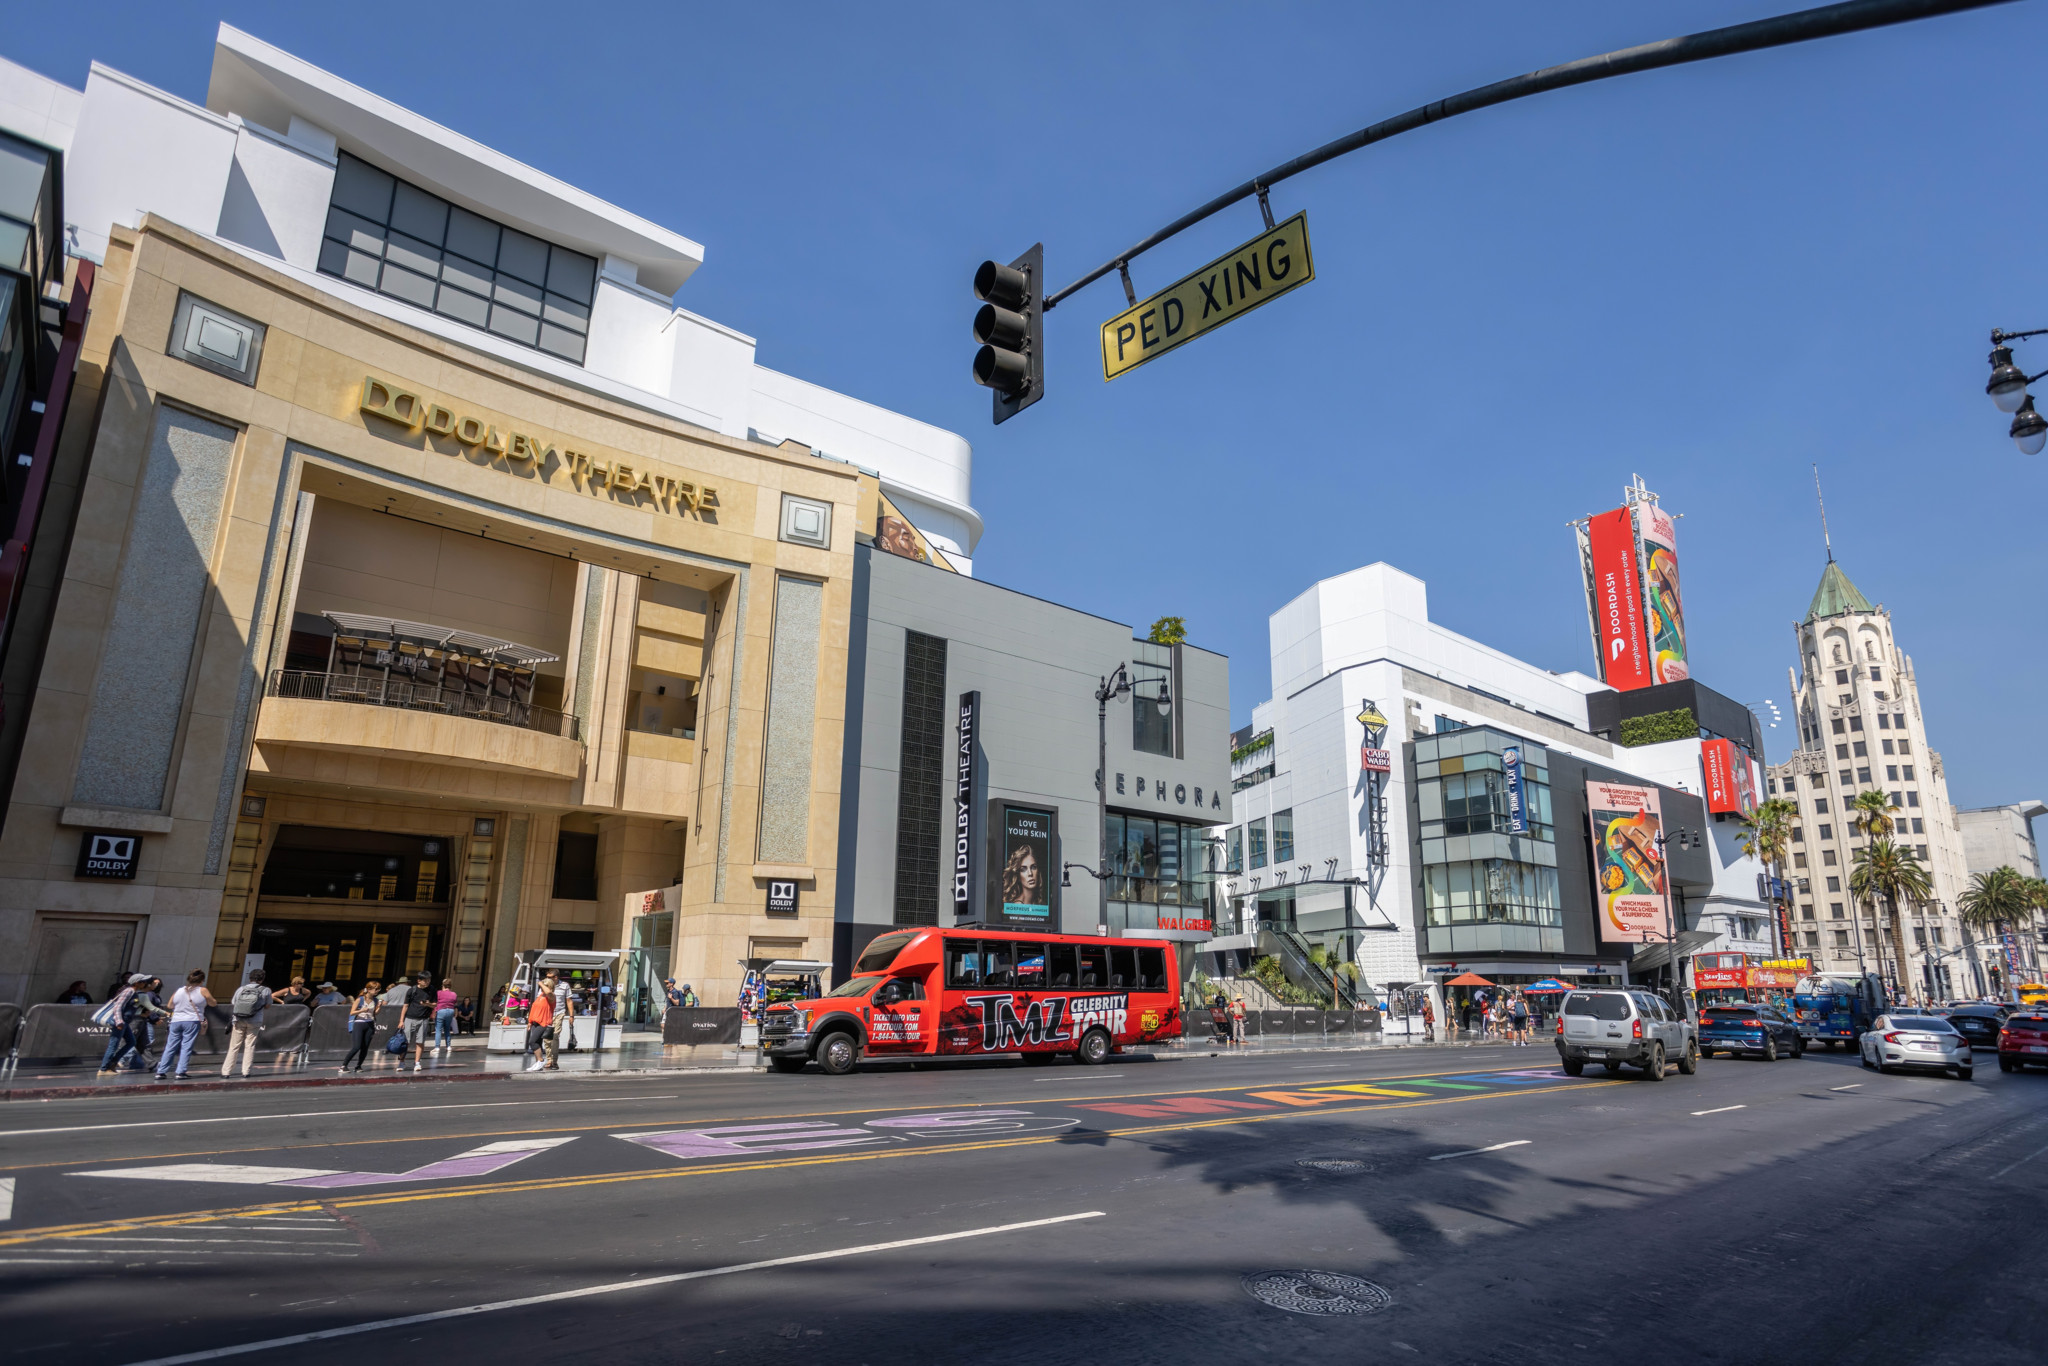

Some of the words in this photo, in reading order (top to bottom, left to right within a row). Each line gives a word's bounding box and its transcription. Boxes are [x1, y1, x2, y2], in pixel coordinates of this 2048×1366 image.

[1117, 298, 1184, 361] PED
[1199, 239, 1291, 320] XING
[425, 403, 554, 467] DOLBY
[564, 450, 718, 511] THEATRE
[1605, 572, 1622, 635] DOORDASH
[1626, 595, 1635, 613] good
[1629, 622, 1641, 669] neighborhood
[958, 704, 972, 796] THEATRE
[1366, 750, 1389, 759] CABO
[1367, 757, 1390, 766] WABO
[1709, 750, 1719, 788] DOORDASH
[1507, 769, 1517, 785] PLAY
[1509, 791, 1520, 812] DRINK
[1008, 827, 1029, 838] YOUR
[1030, 829, 1047, 839] SKIN
[1018, 819, 1038, 829] LOVE
[1512, 819, 1521, 830] EAT
[956, 802, 969, 870] DOLBY
[87, 861, 129, 870] DOLBY
[1783, 934, 1791, 948] Foot
[1070, 995, 1127, 1013] CELEBRITY
[873, 1023, 918, 1031] TMZTOUR.COM
[966, 993, 1071, 1051] TMZ
[1072, 1009, 1128, 1040] TOUR
[1142, 1014, 1152, 1022] BIG
[872, 1032, 920, 1040] 1-844-TMZ-TOUR
